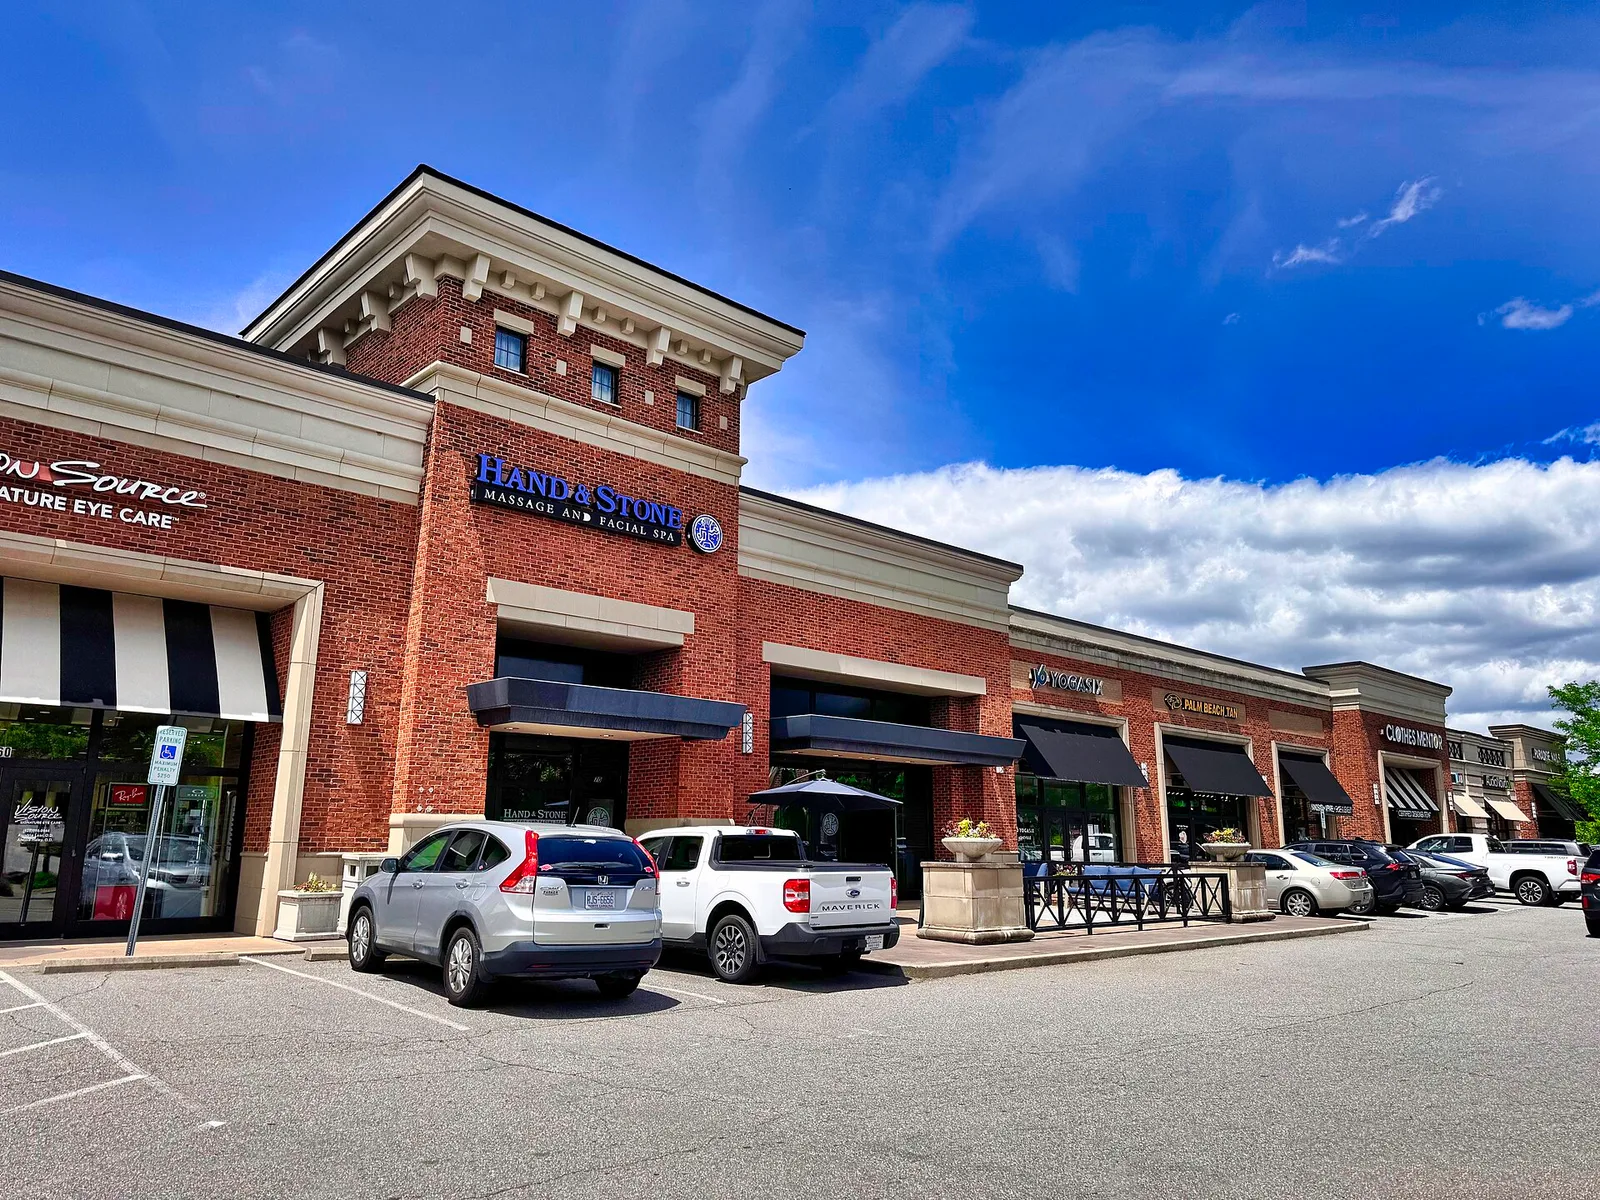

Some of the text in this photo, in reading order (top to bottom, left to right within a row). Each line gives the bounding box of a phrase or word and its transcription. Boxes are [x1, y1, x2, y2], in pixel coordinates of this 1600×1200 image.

[574, 484, 591, 505] &
[74, 499, 113, 518] EYE
[485, 489, 674, 541] MASSAGE AND FACIAL SPA
[1050, 671, 1104, 696] YOGASIX
[1184, 699, 1238, 718] PALM BEACH TAN
[160, 729, 184, 737] RESERVED
[1386, 724, 1443, 750] CLOTHES MENTOR
[822, 903, 880, 912] MAVERICK
